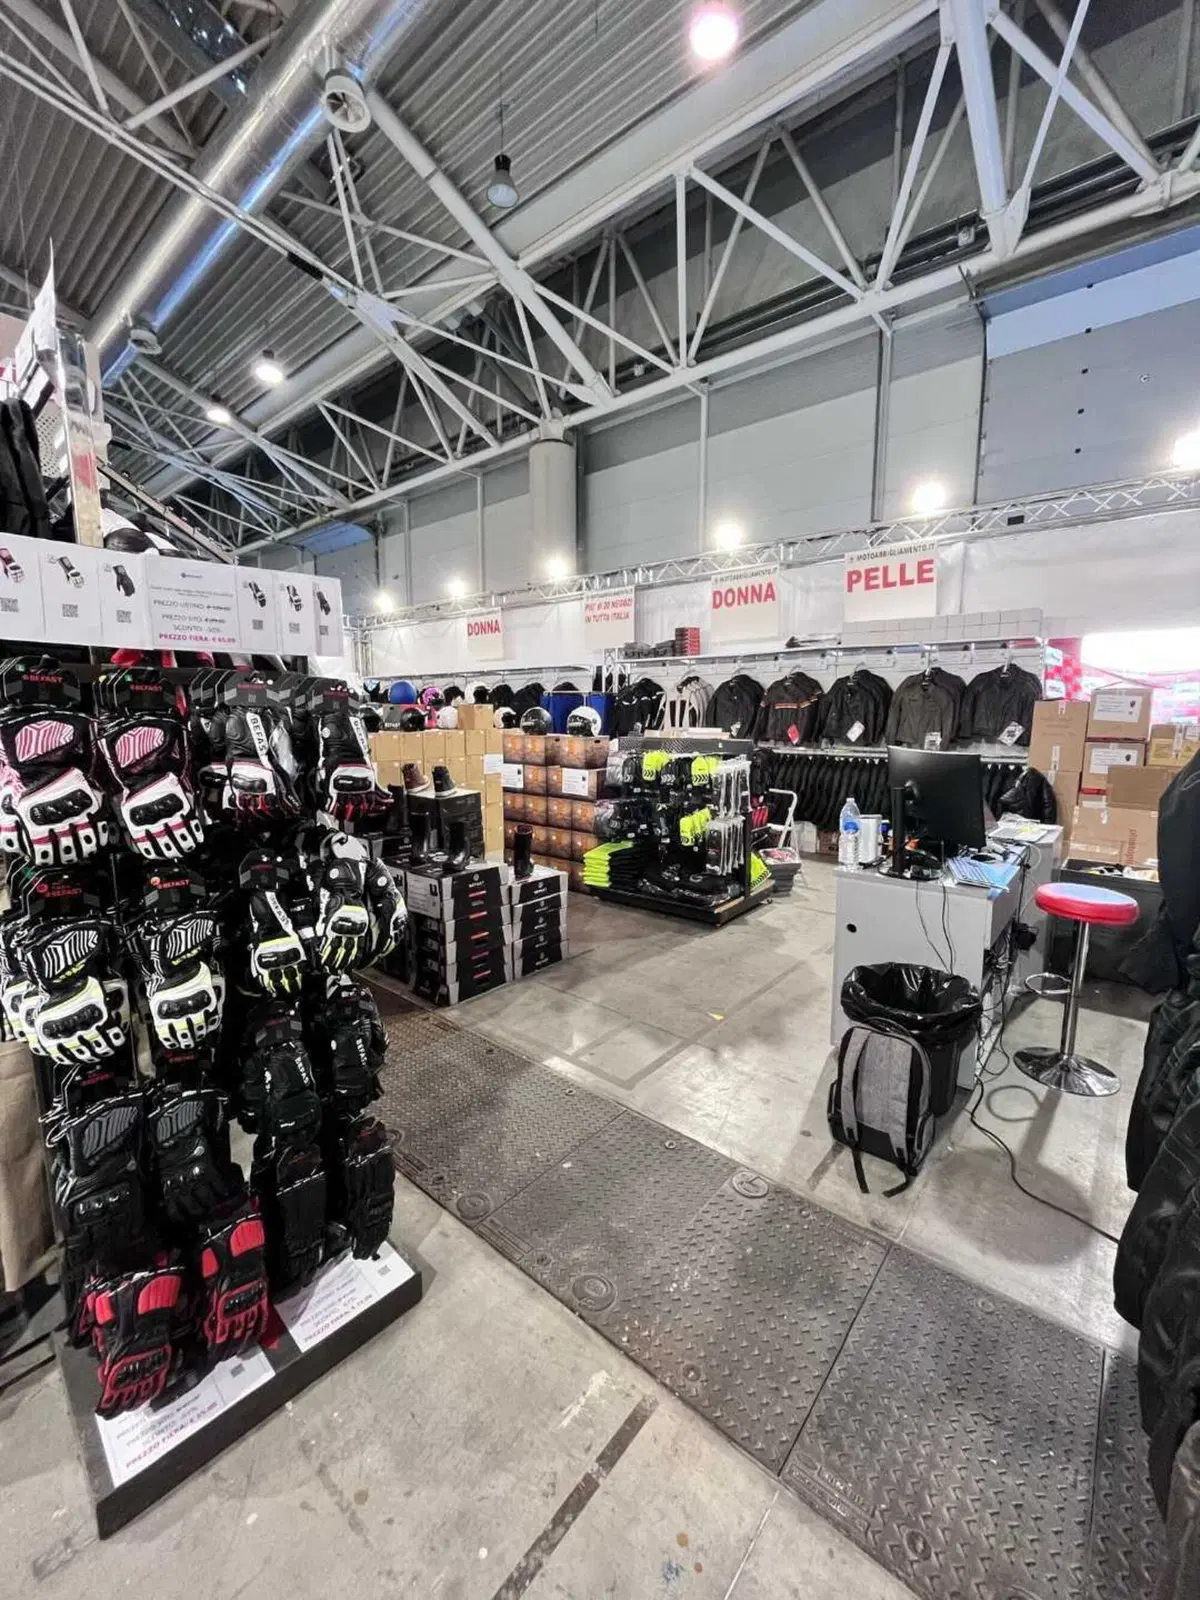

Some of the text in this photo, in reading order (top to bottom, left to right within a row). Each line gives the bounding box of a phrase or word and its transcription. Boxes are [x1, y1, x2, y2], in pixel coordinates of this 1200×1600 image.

[847, 559, 935, 593] PELLE
[712, 581, 776, 609] DONNA
[585, 611, 630, 623] IN TUTTA ITALIA
[467, 619, 501, 637] DONNA
[159, 633, 187, 641] PREZZO
[29, 675, 63, 684] BEFAST
